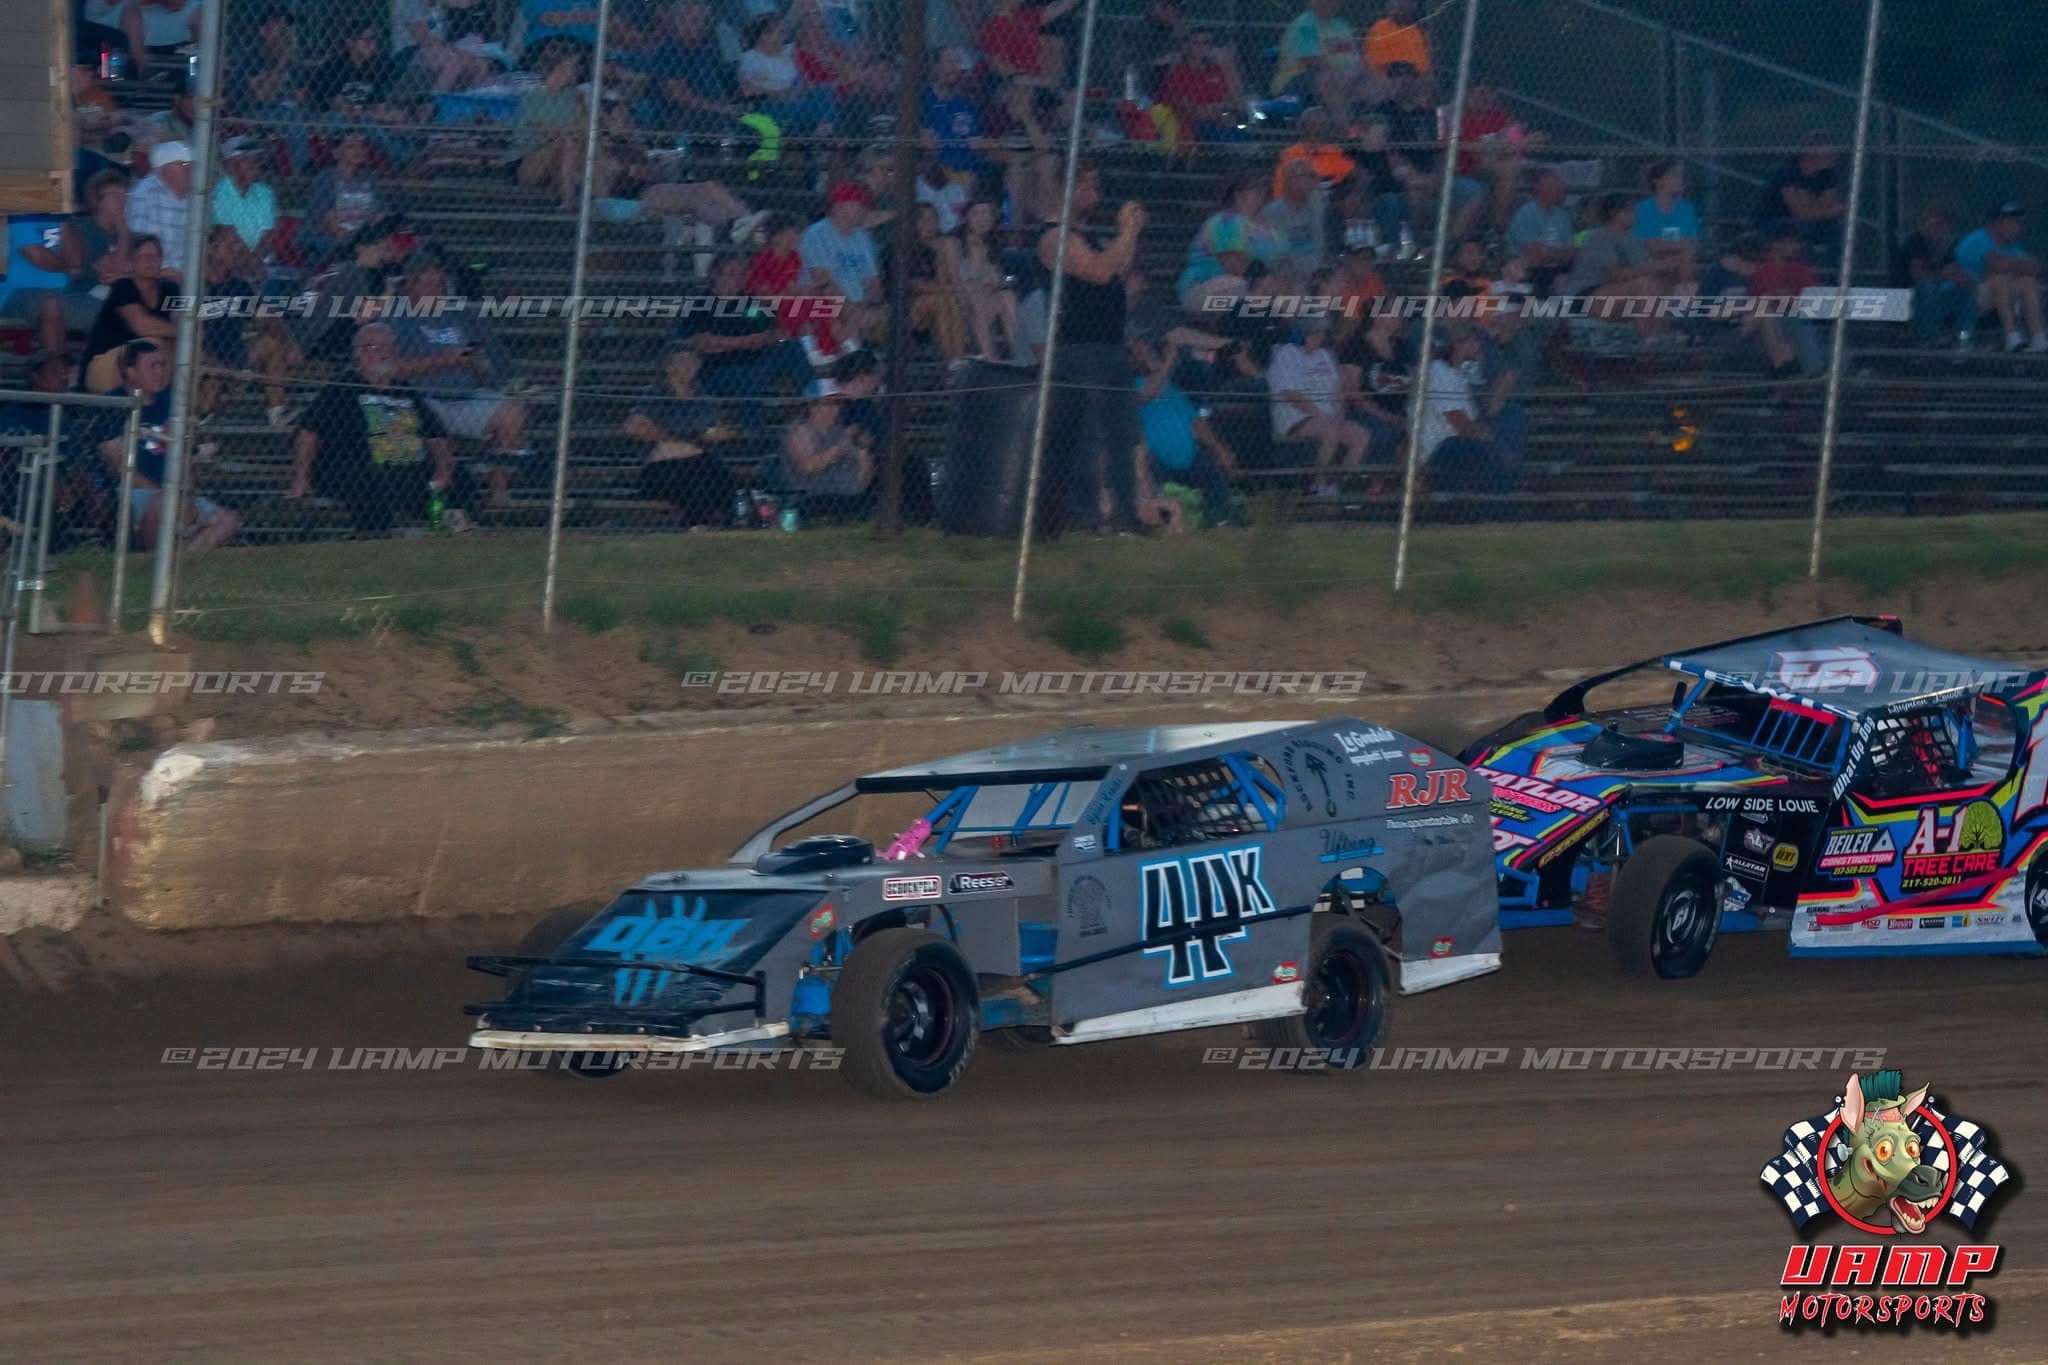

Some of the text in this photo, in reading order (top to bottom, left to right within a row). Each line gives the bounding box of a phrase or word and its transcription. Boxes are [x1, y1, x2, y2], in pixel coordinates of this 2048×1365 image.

[1385, 768, 1472, 809] RJR
[1705, 796, 1819, 813] LOW SIDE LOUIE
[1825, 831, 1874, 856] BEILER
[1906, 805, 1969, 856] A-1
[1732, 859, 1766, 873] ALLSTAR
[1820, 853, 1895, 868] CONSTRUCTION
[1903, 851, 2000, 878] TREE CARE
[1141, 845, 1277, 985] 44K
